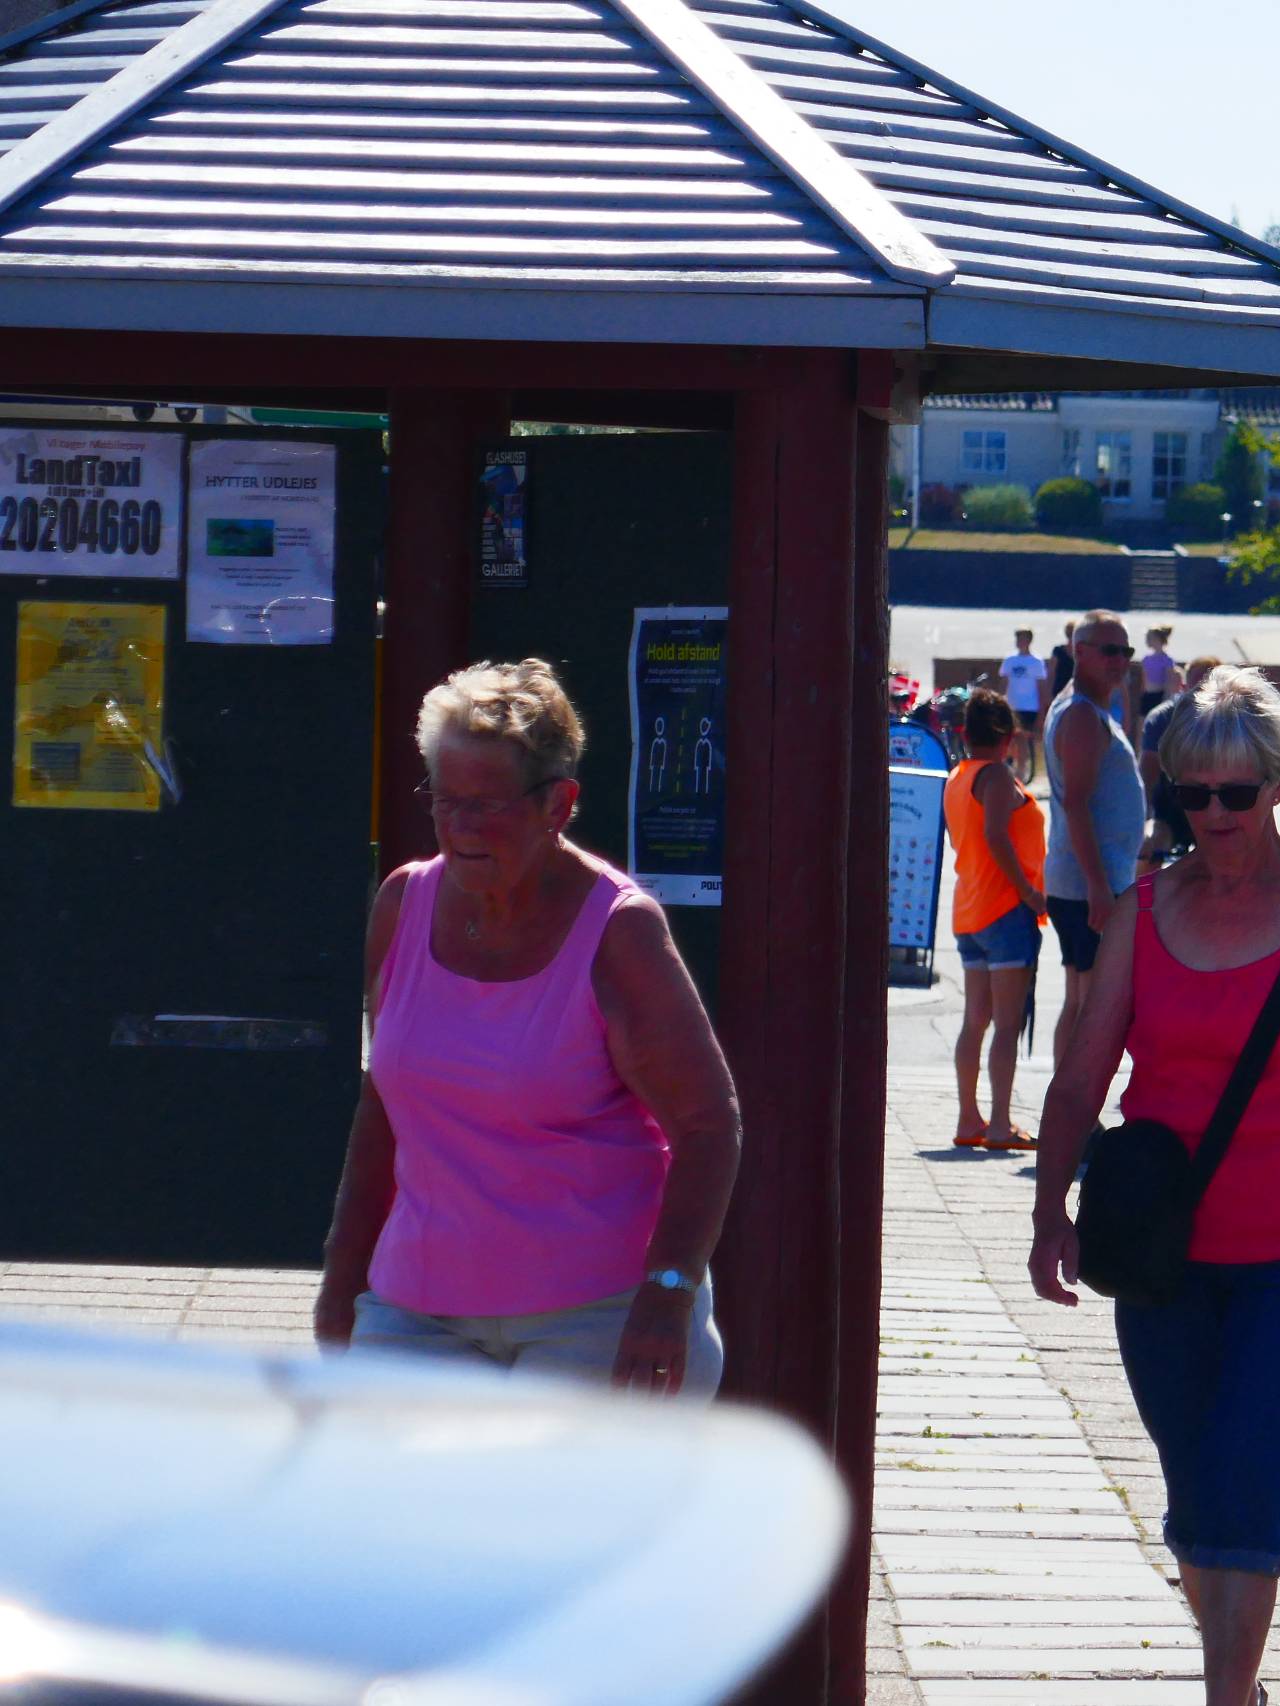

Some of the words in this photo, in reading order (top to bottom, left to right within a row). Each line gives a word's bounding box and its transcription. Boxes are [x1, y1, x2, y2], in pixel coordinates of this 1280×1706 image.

[16, 453, 141, 487] LandTaxi
[206, 475, 259, 489] HYTTER
[263, 477, 319, 491] UDLEJES
[0, 496, 161, 556] 20204660
[481, 563, 523, 576] GALLERIET
[647, 642, 675, 660] Hold
[678, 642, 720, 661] afstand
